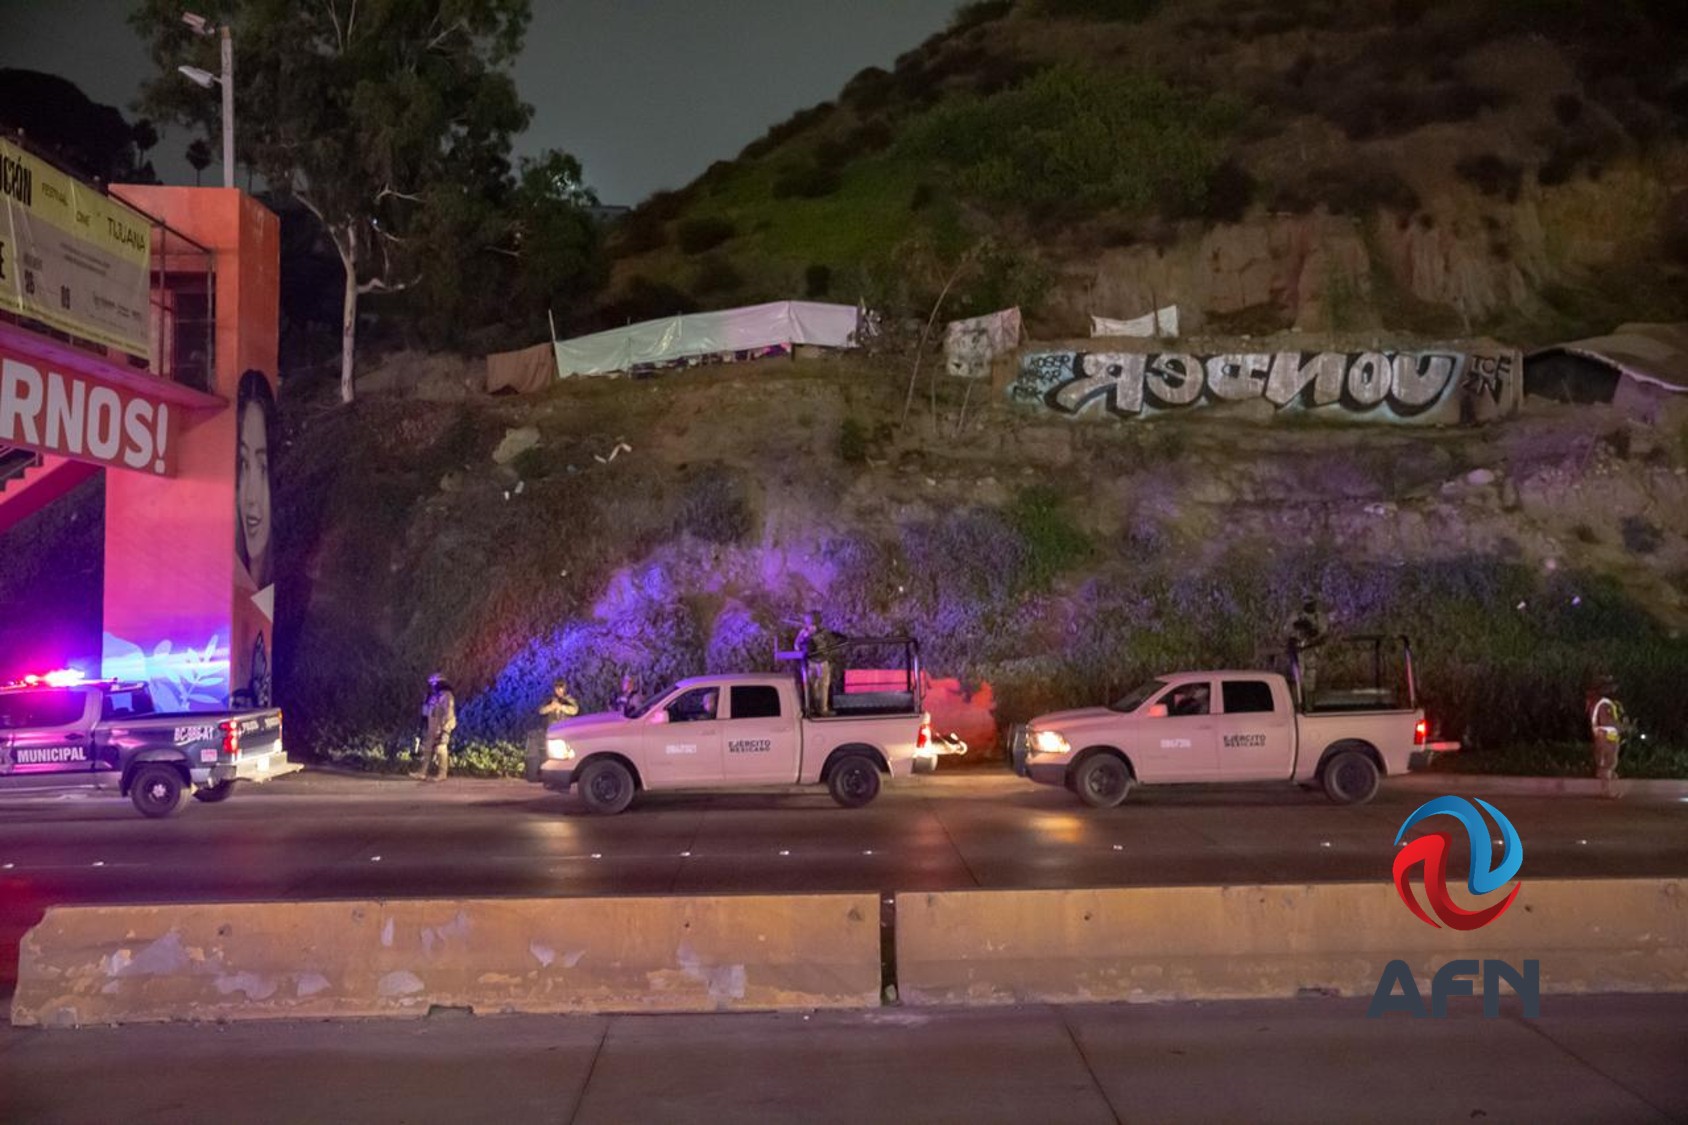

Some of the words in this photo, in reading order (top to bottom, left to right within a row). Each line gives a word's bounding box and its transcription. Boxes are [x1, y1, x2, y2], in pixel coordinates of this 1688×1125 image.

[107, 217, 146, 253] TIJUANA
[0, 357, 169, 474] RNOS!
[17, 747, 87, 763] MUNICIPAL
